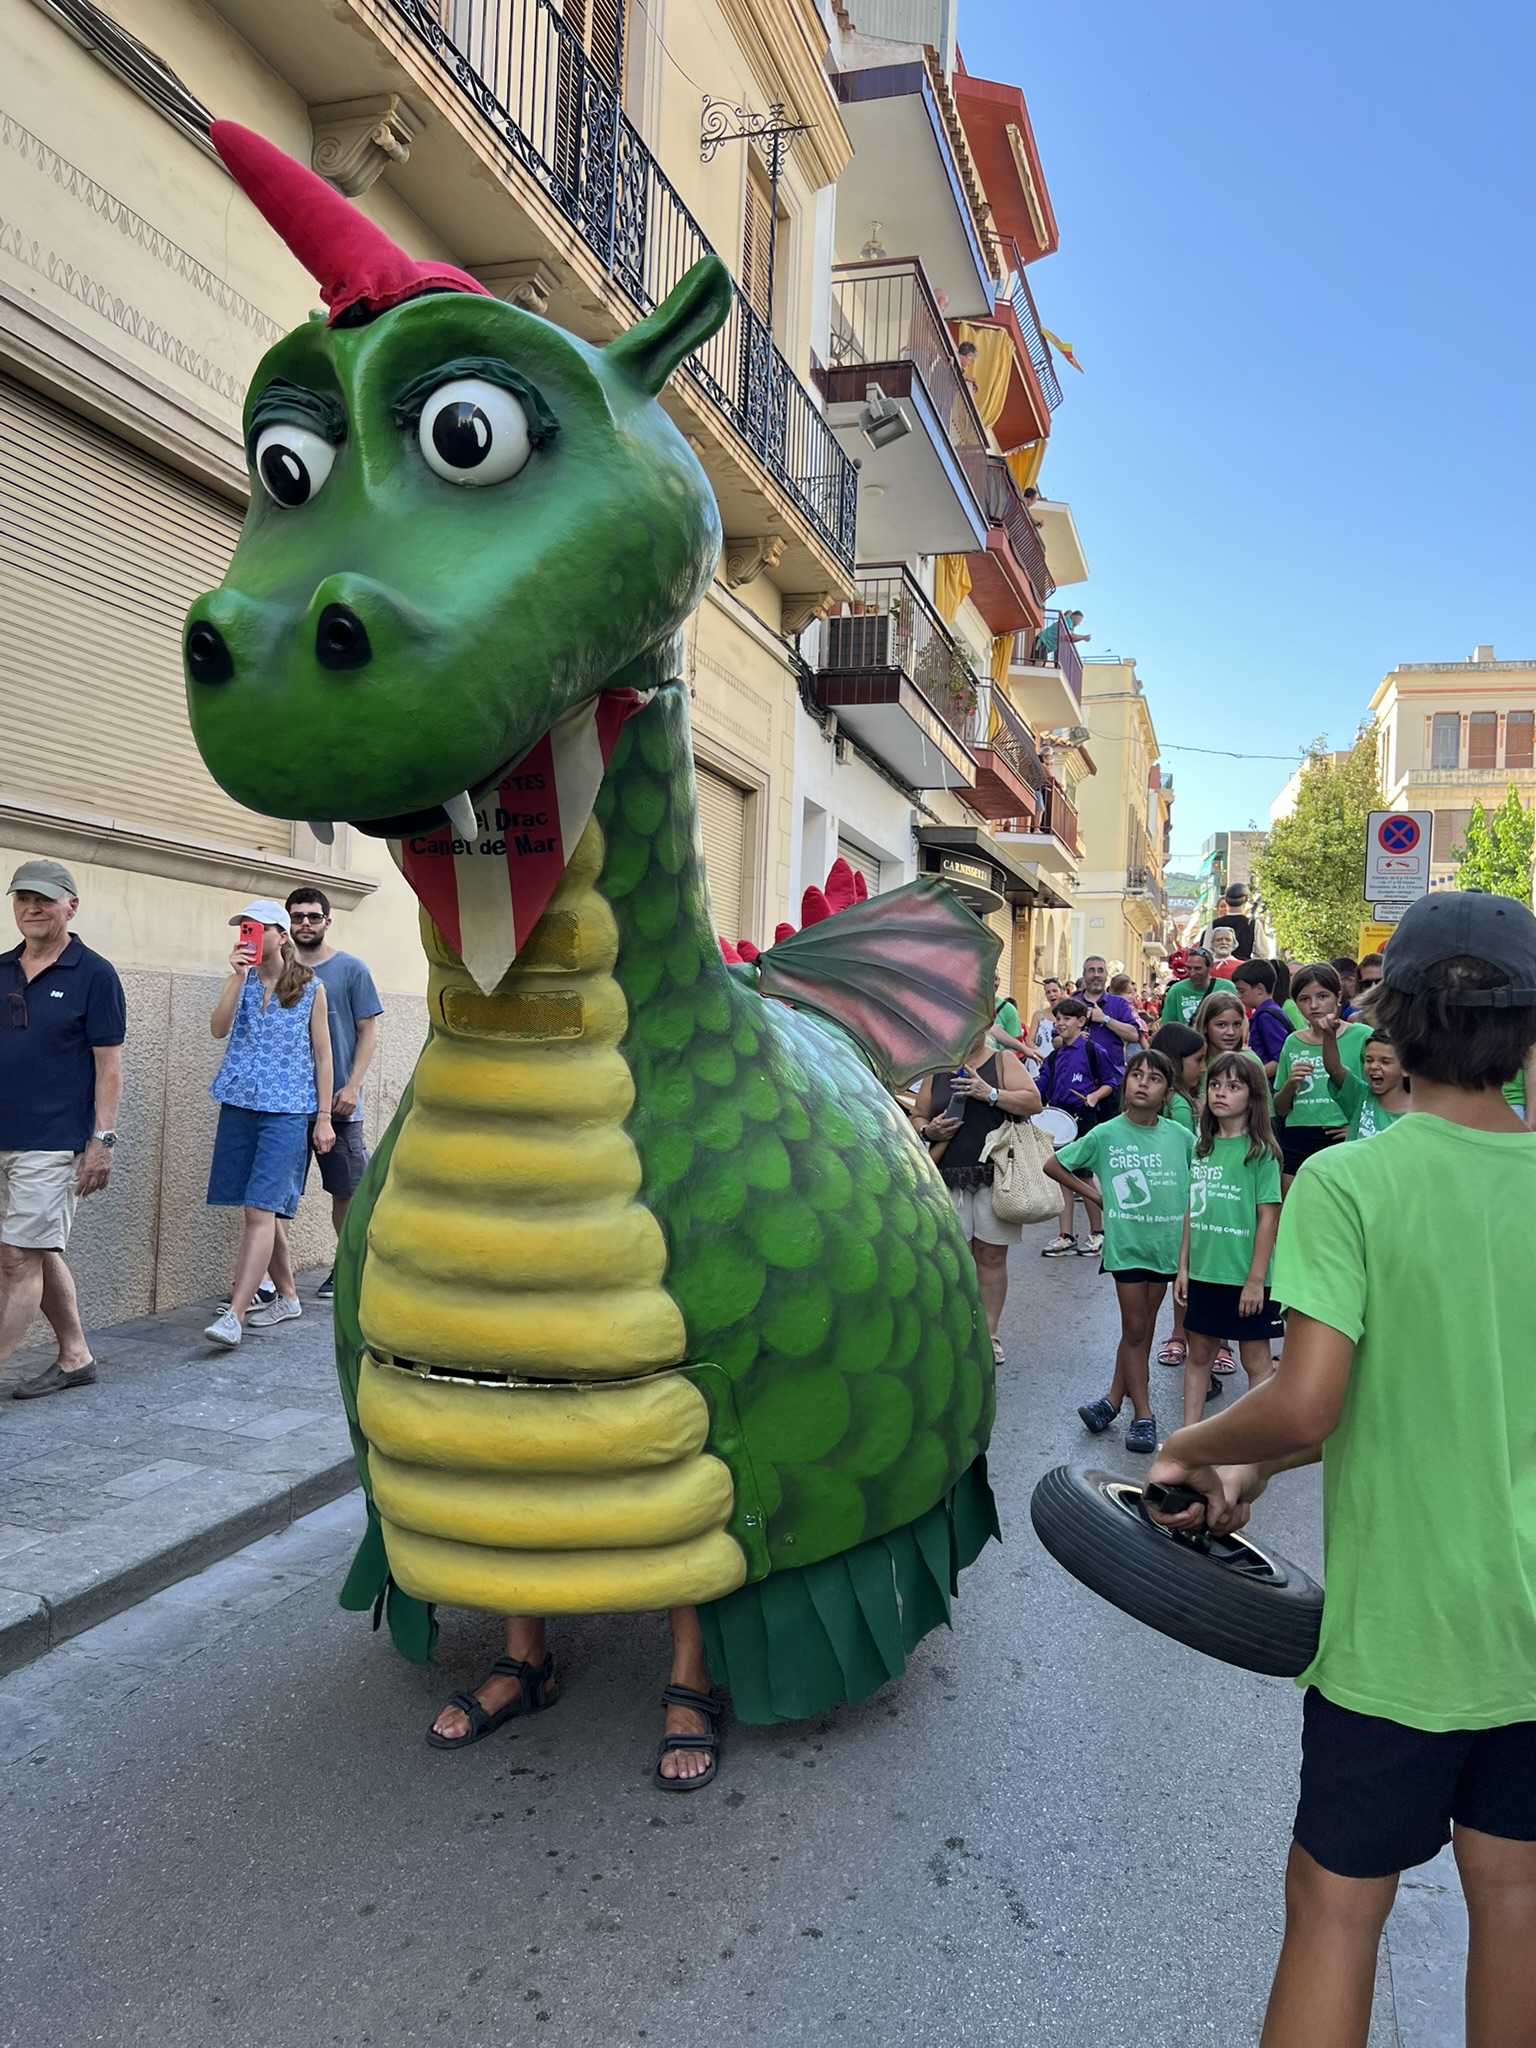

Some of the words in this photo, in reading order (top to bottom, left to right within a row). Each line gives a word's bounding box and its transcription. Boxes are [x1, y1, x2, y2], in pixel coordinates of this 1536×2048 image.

[495, 808, 548, 832] Drac
[479, 839, 507, 856] de
[514, 833, 557, 857] Mar
[1127, 1144, 1139, 1152] en
[1109, 1153, 1162, 1169] CRESTES
